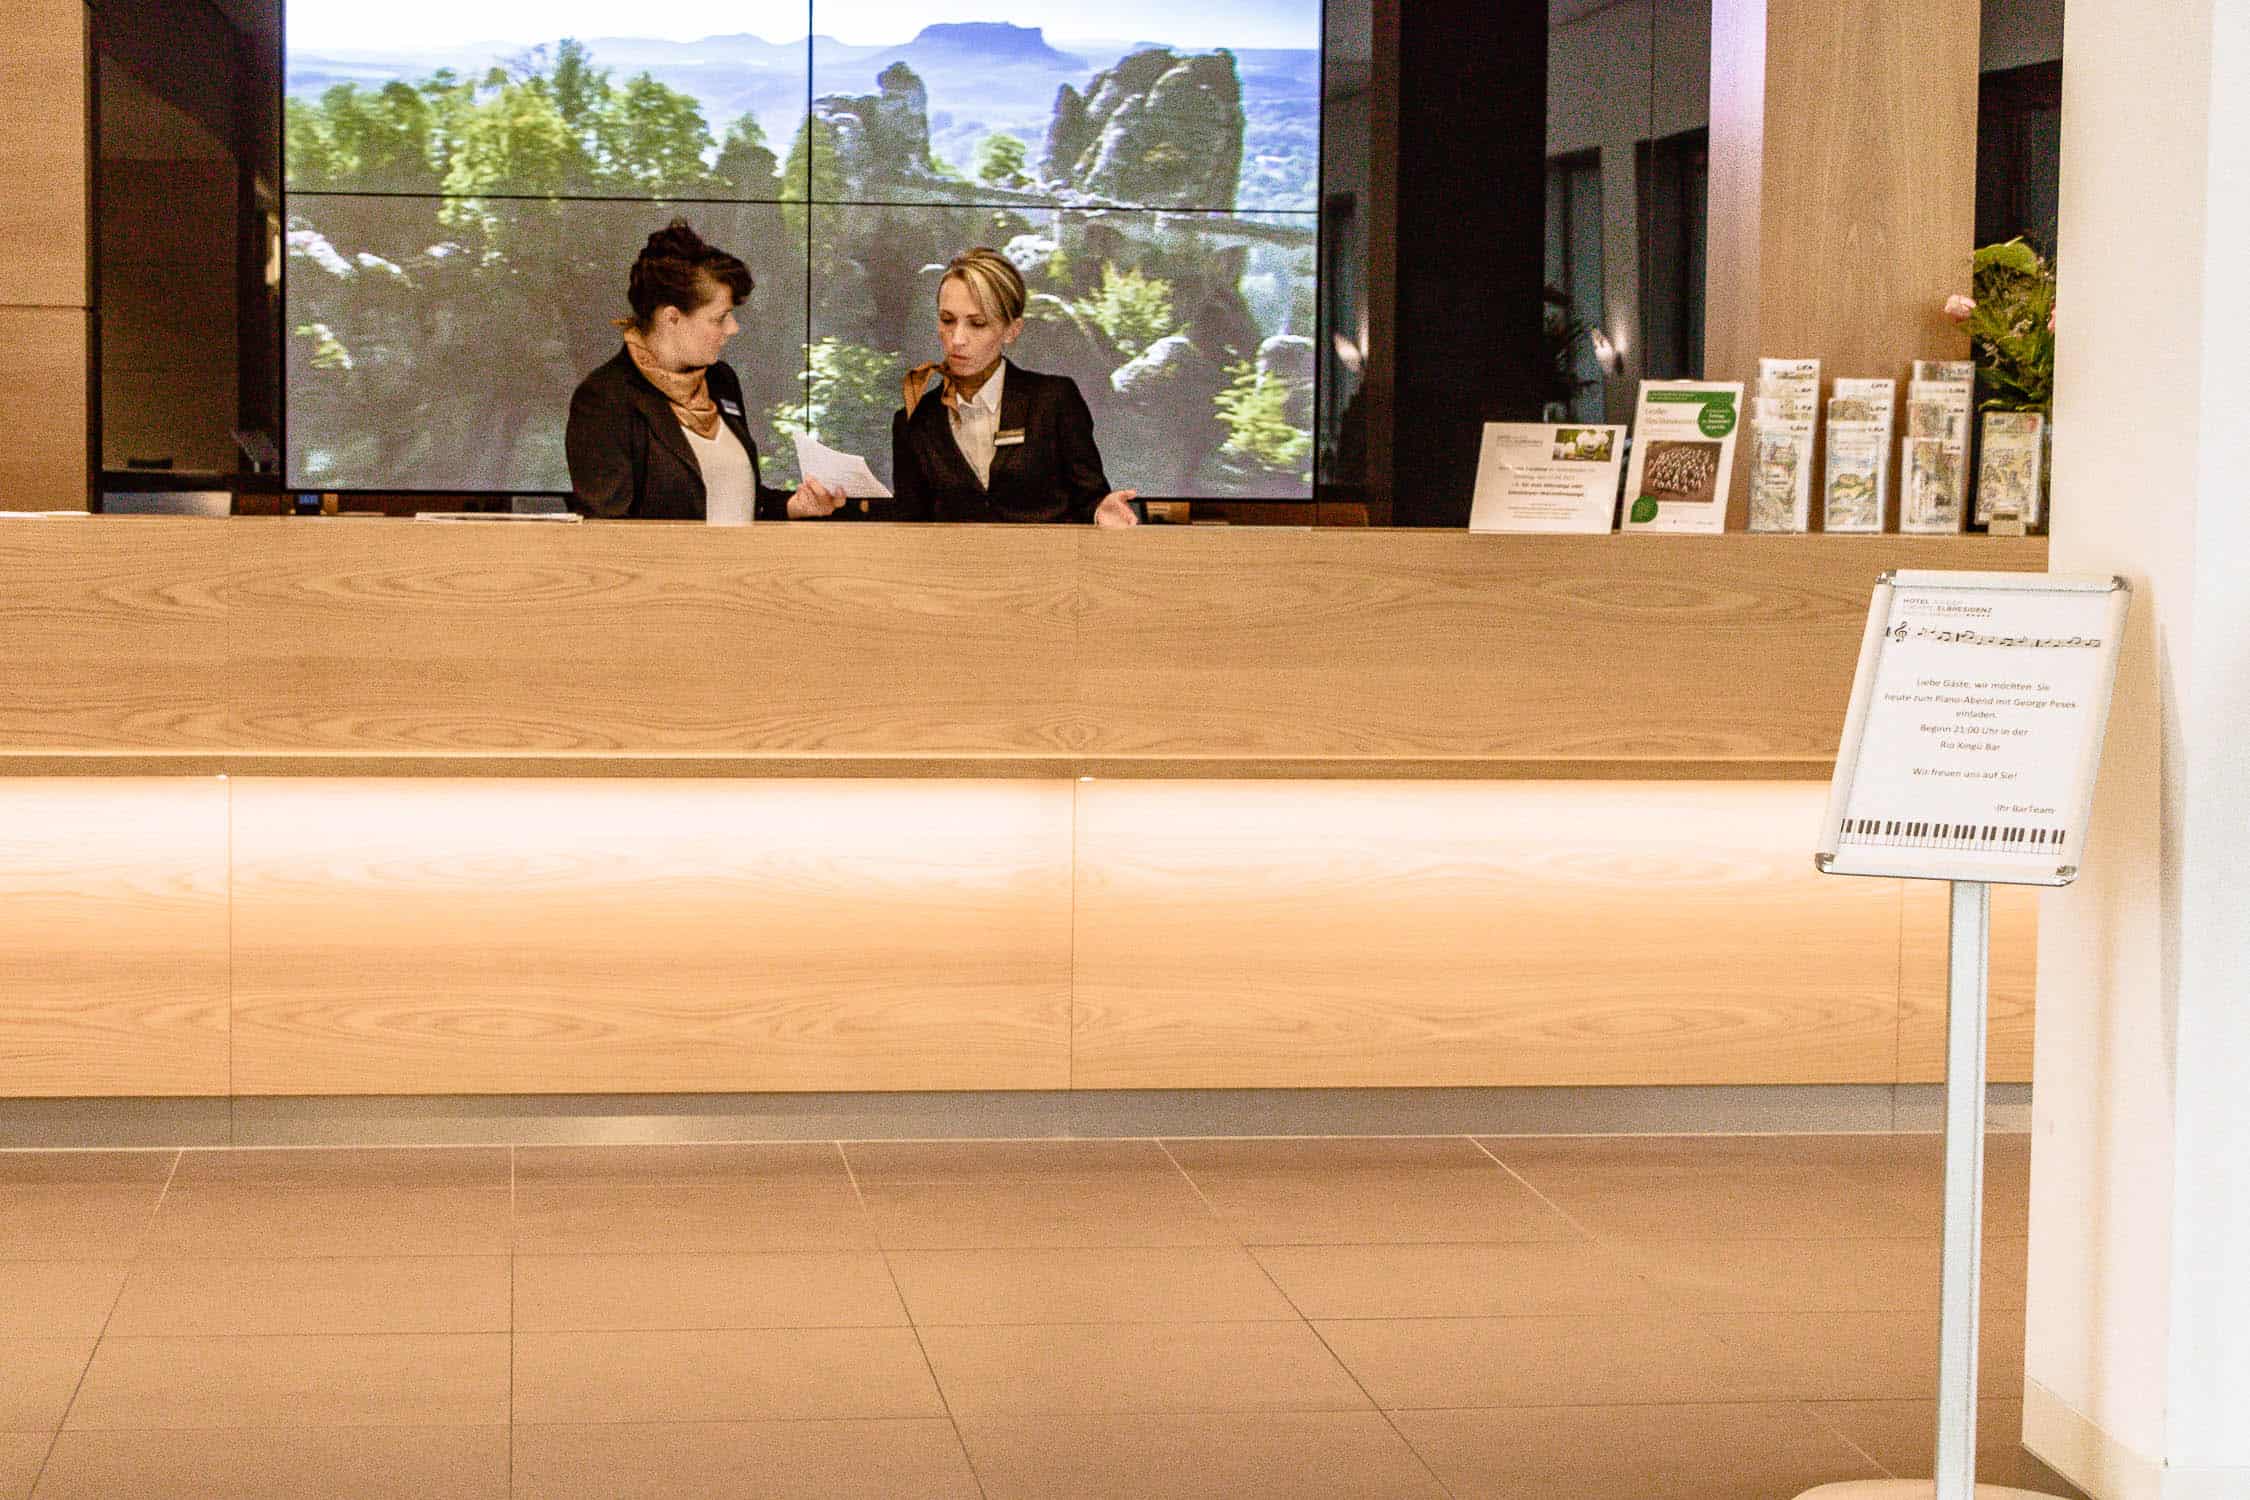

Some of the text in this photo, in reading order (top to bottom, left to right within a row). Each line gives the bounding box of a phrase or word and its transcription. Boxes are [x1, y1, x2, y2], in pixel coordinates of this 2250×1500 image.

[1916, 678, 1941, 688] Liebe
[1974, 681, 1989, 689] wir
[1991, 681, 2032, 691] möchten
[2037, 681, 2050, 691] Sie
[1885, 693, 1912, 702] heute
[1913, 694, 1933, 702] zum
[1995, 696, 2011, 705] mit
[1919, 724, 1951, 734] Beginn
[1982, 727, 1999, 736] Uhr
[2001, 727, 2010, 736] in
[2012, 728, 2029, 736] der
[1985, 743, 2001, 752] Bar
[1912, 767, 1930, 776] Wir
[1931, 768, 1961, 777] freuen
[1982, 771, 1998, 779] auf
